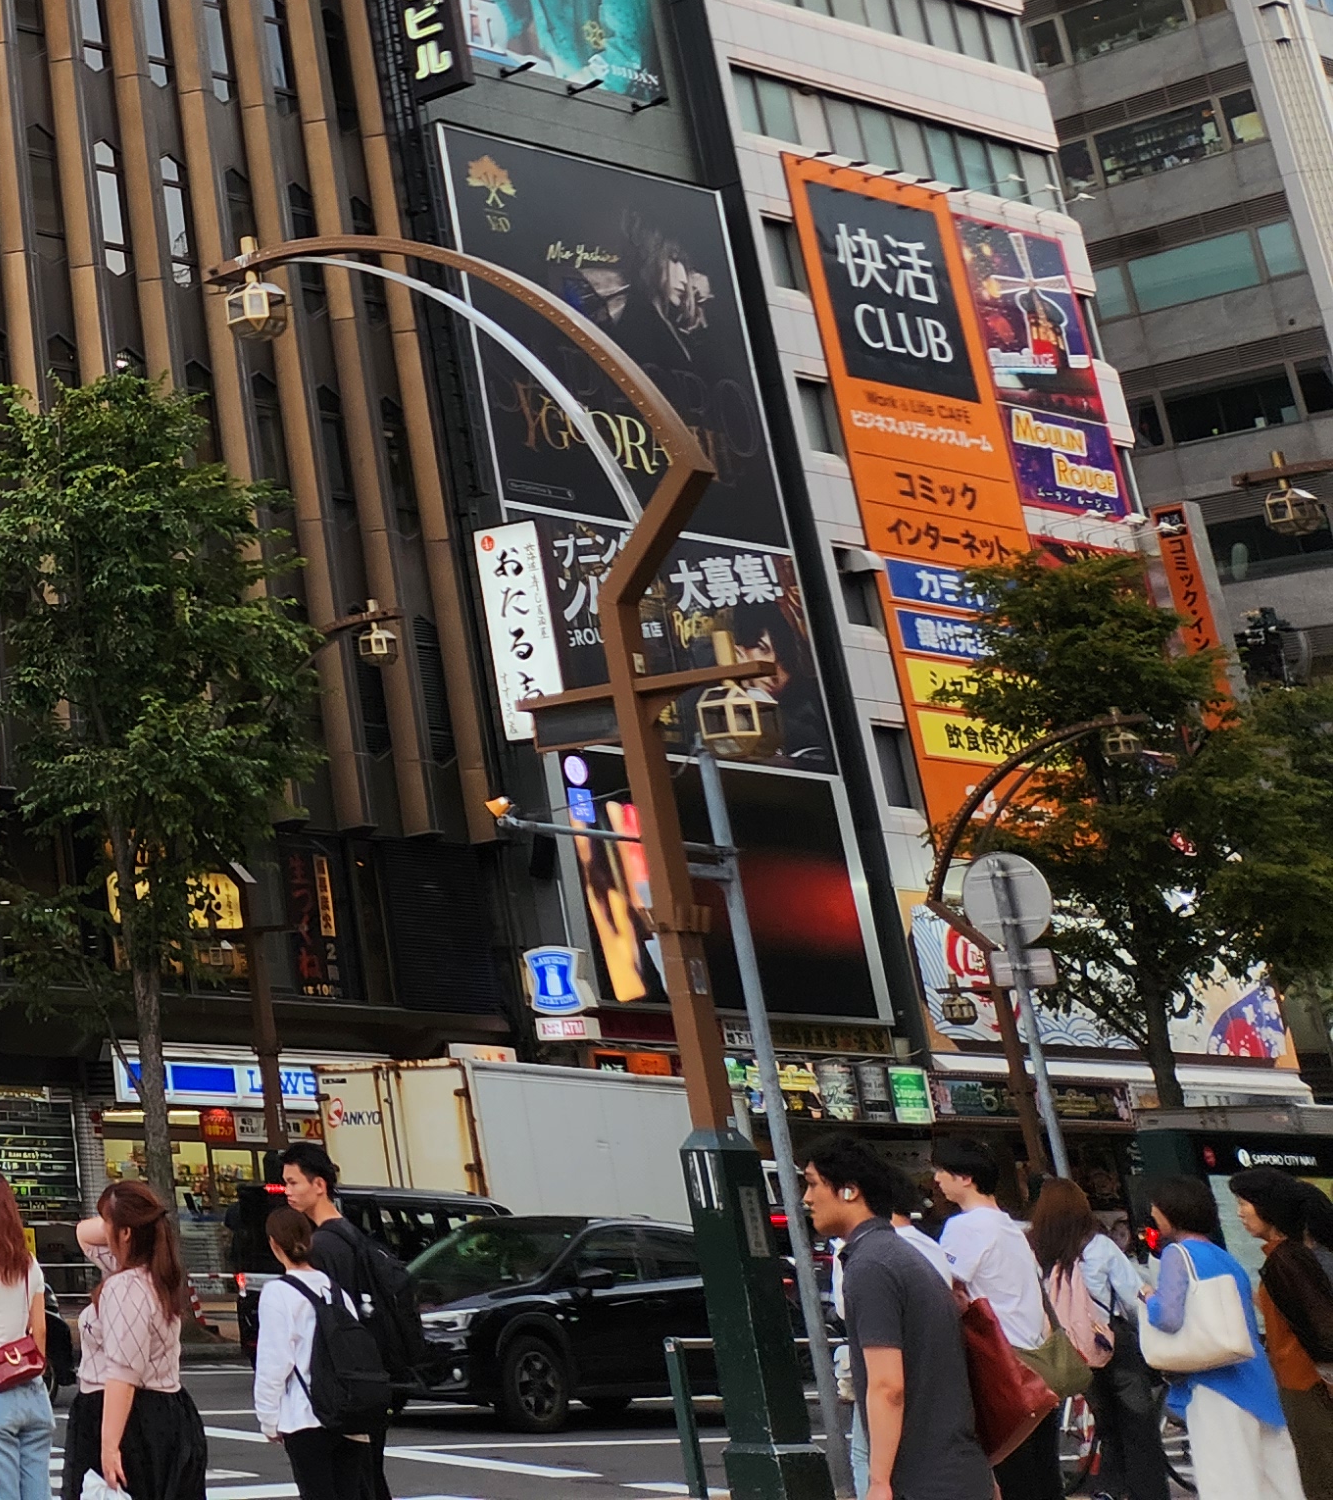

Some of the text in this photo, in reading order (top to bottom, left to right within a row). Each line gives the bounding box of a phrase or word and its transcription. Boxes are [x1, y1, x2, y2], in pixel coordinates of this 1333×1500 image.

[835, 222, 939, 304] 快活
[854, 303, 954, 363] CLUB
[1013, 411, 1086, 455] MOULIN
[894, 470, 978, 511] コミック
[1054, 455, 1117, 496] ROUGE
[887, 517, 1013, 564] インターネット
[668, 552, 784, 613] 大募集!
[538, 994, 576, 1005] STATION
[564, 1020, 585, 1036] ATM
[246, 1068, 317, 1095] LWS
[1251, 1153, 1317, 1168] SAPPORO CITY NAVI
